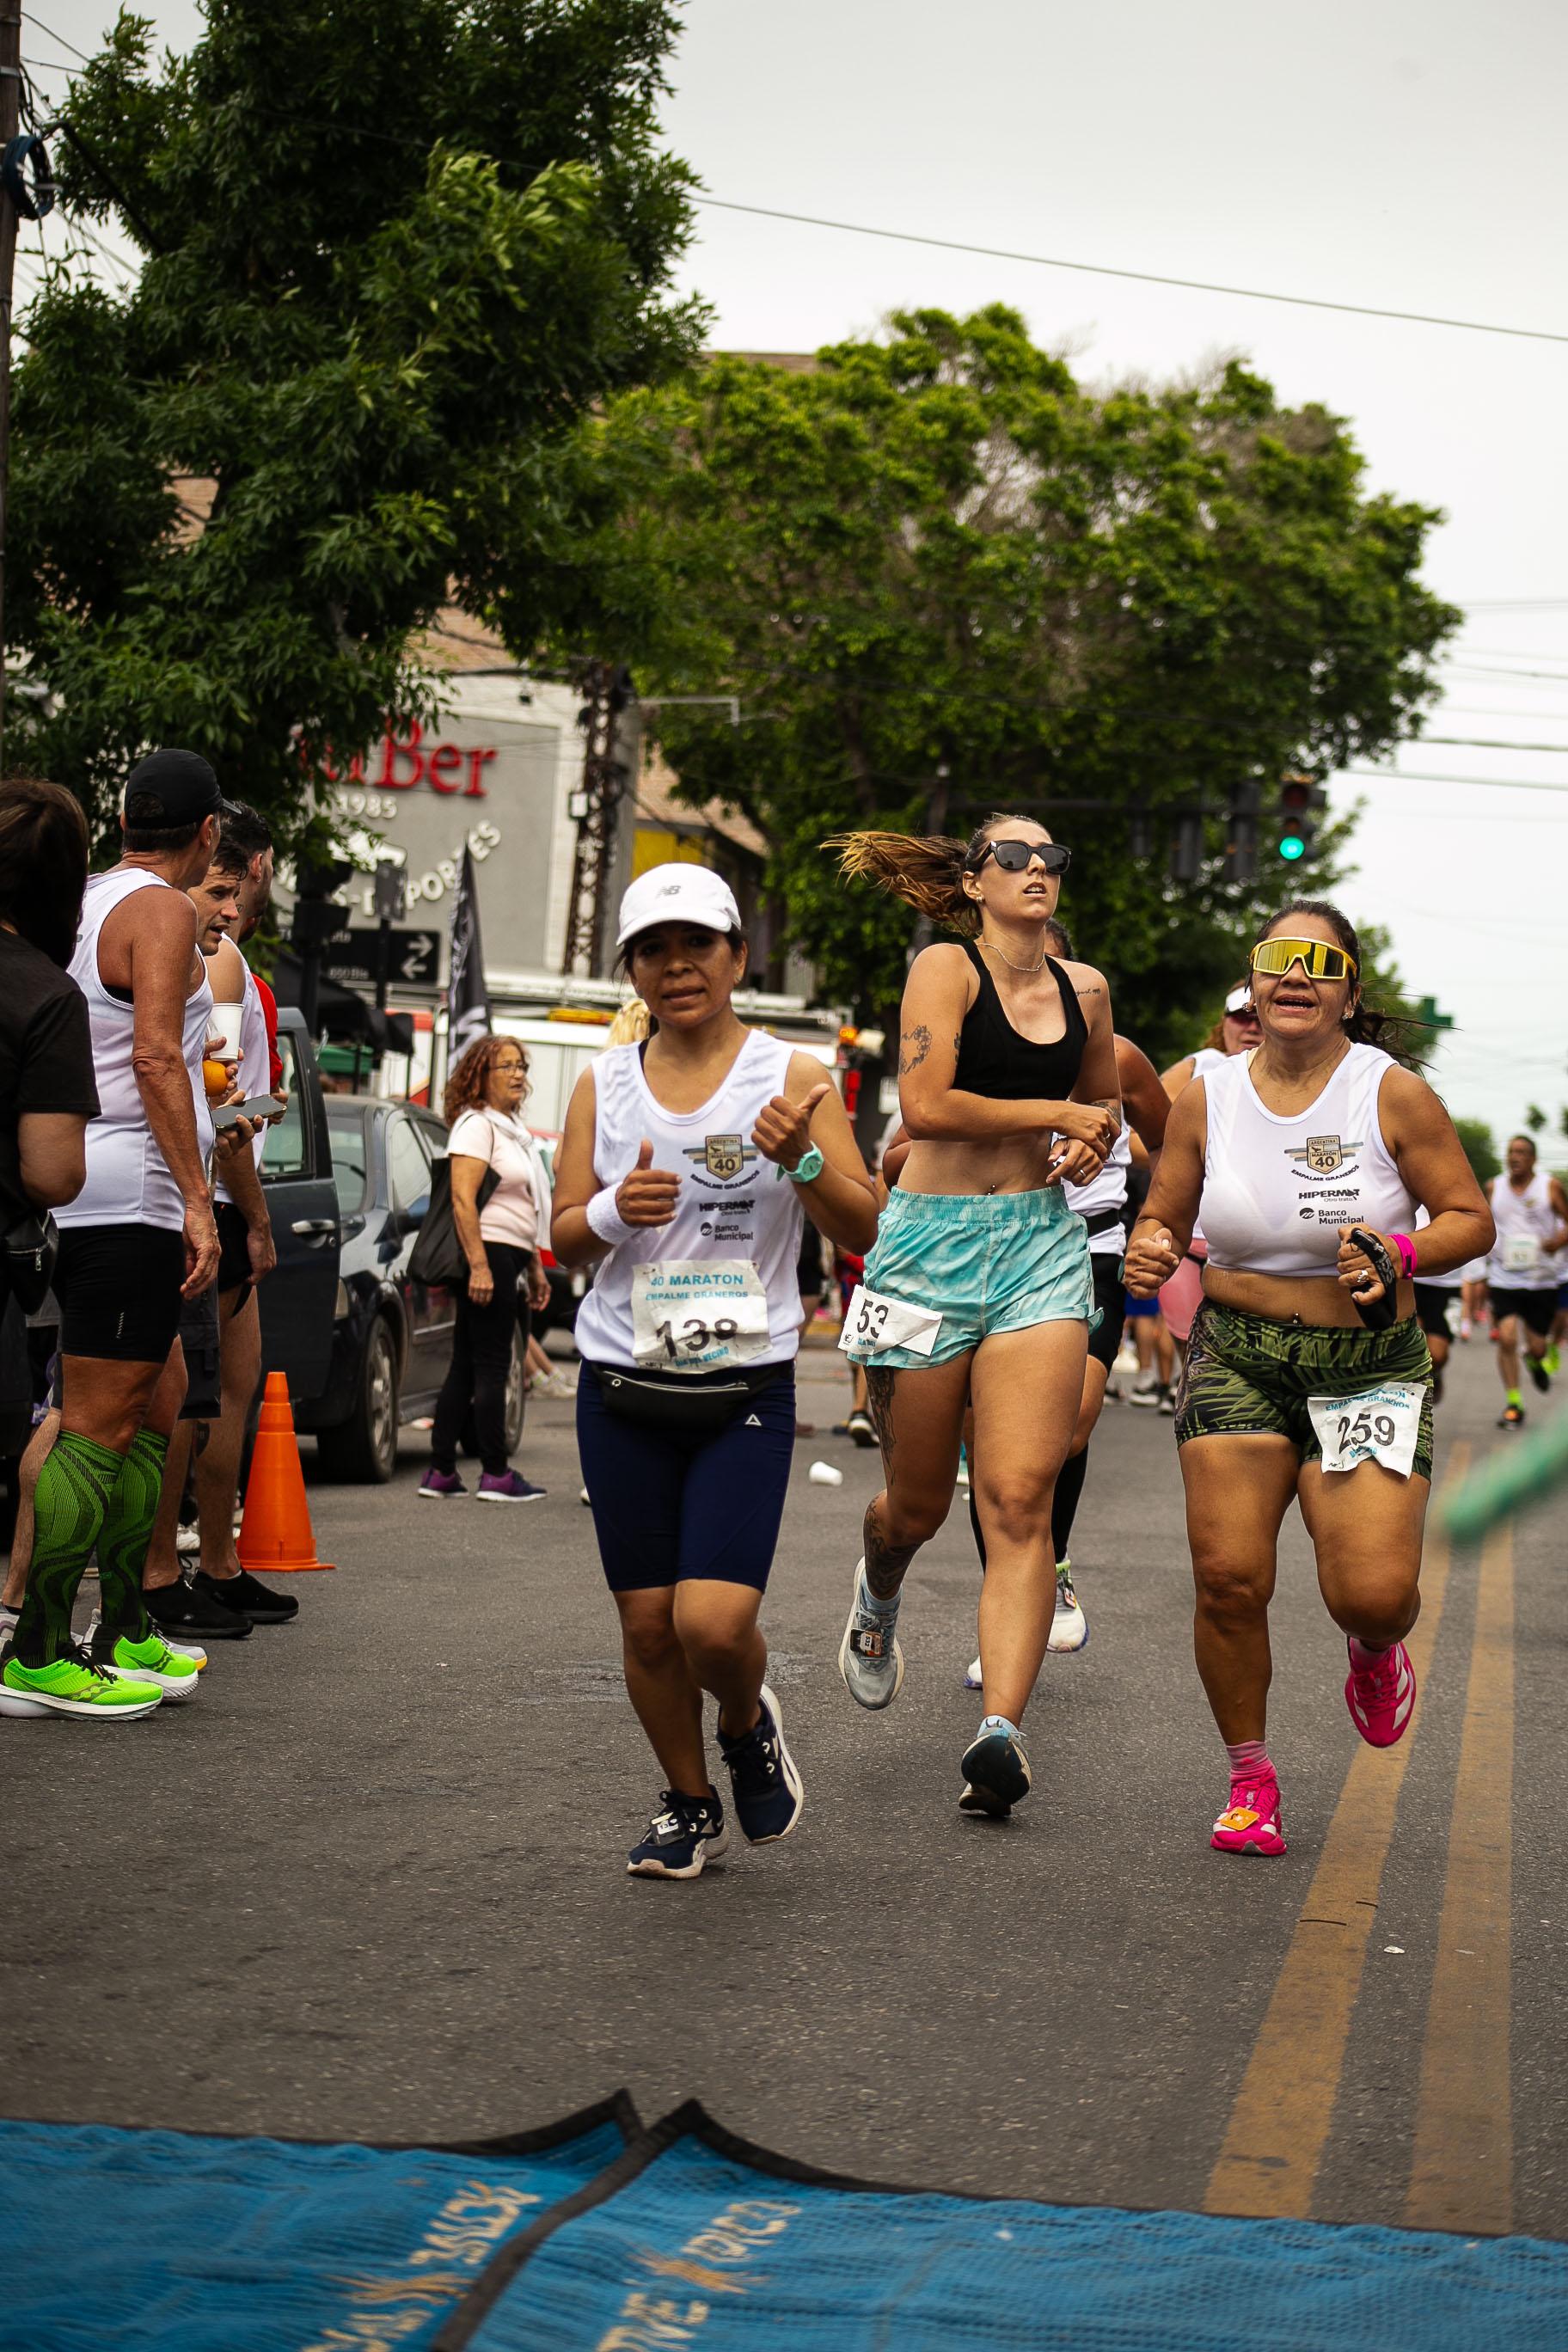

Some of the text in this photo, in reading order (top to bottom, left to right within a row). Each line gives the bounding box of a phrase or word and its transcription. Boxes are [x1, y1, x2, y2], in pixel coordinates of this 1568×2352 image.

[714, 1158, 736, 1172] 40
[1314, 1156, 1335, 1167] 40
[690, 1169, 761, 1190] EMPALME GRANEROS
[1290, 1165, 1360, 1181] EMPALME GRANEROS
[1319, 1216, 1364, 1225] Municipal
[714, 1225, 739, 1234] Banco
[714, 1232, 754, 1242] Municipal
[651, 1274, 744, 1287] 40 MARATON
[645, 1290, 749, 1302] EMPALME GRANEROS
[1326, 1393, 1367, 1412] EMPAE
[1337, 1412, 1395, 1455] 259
